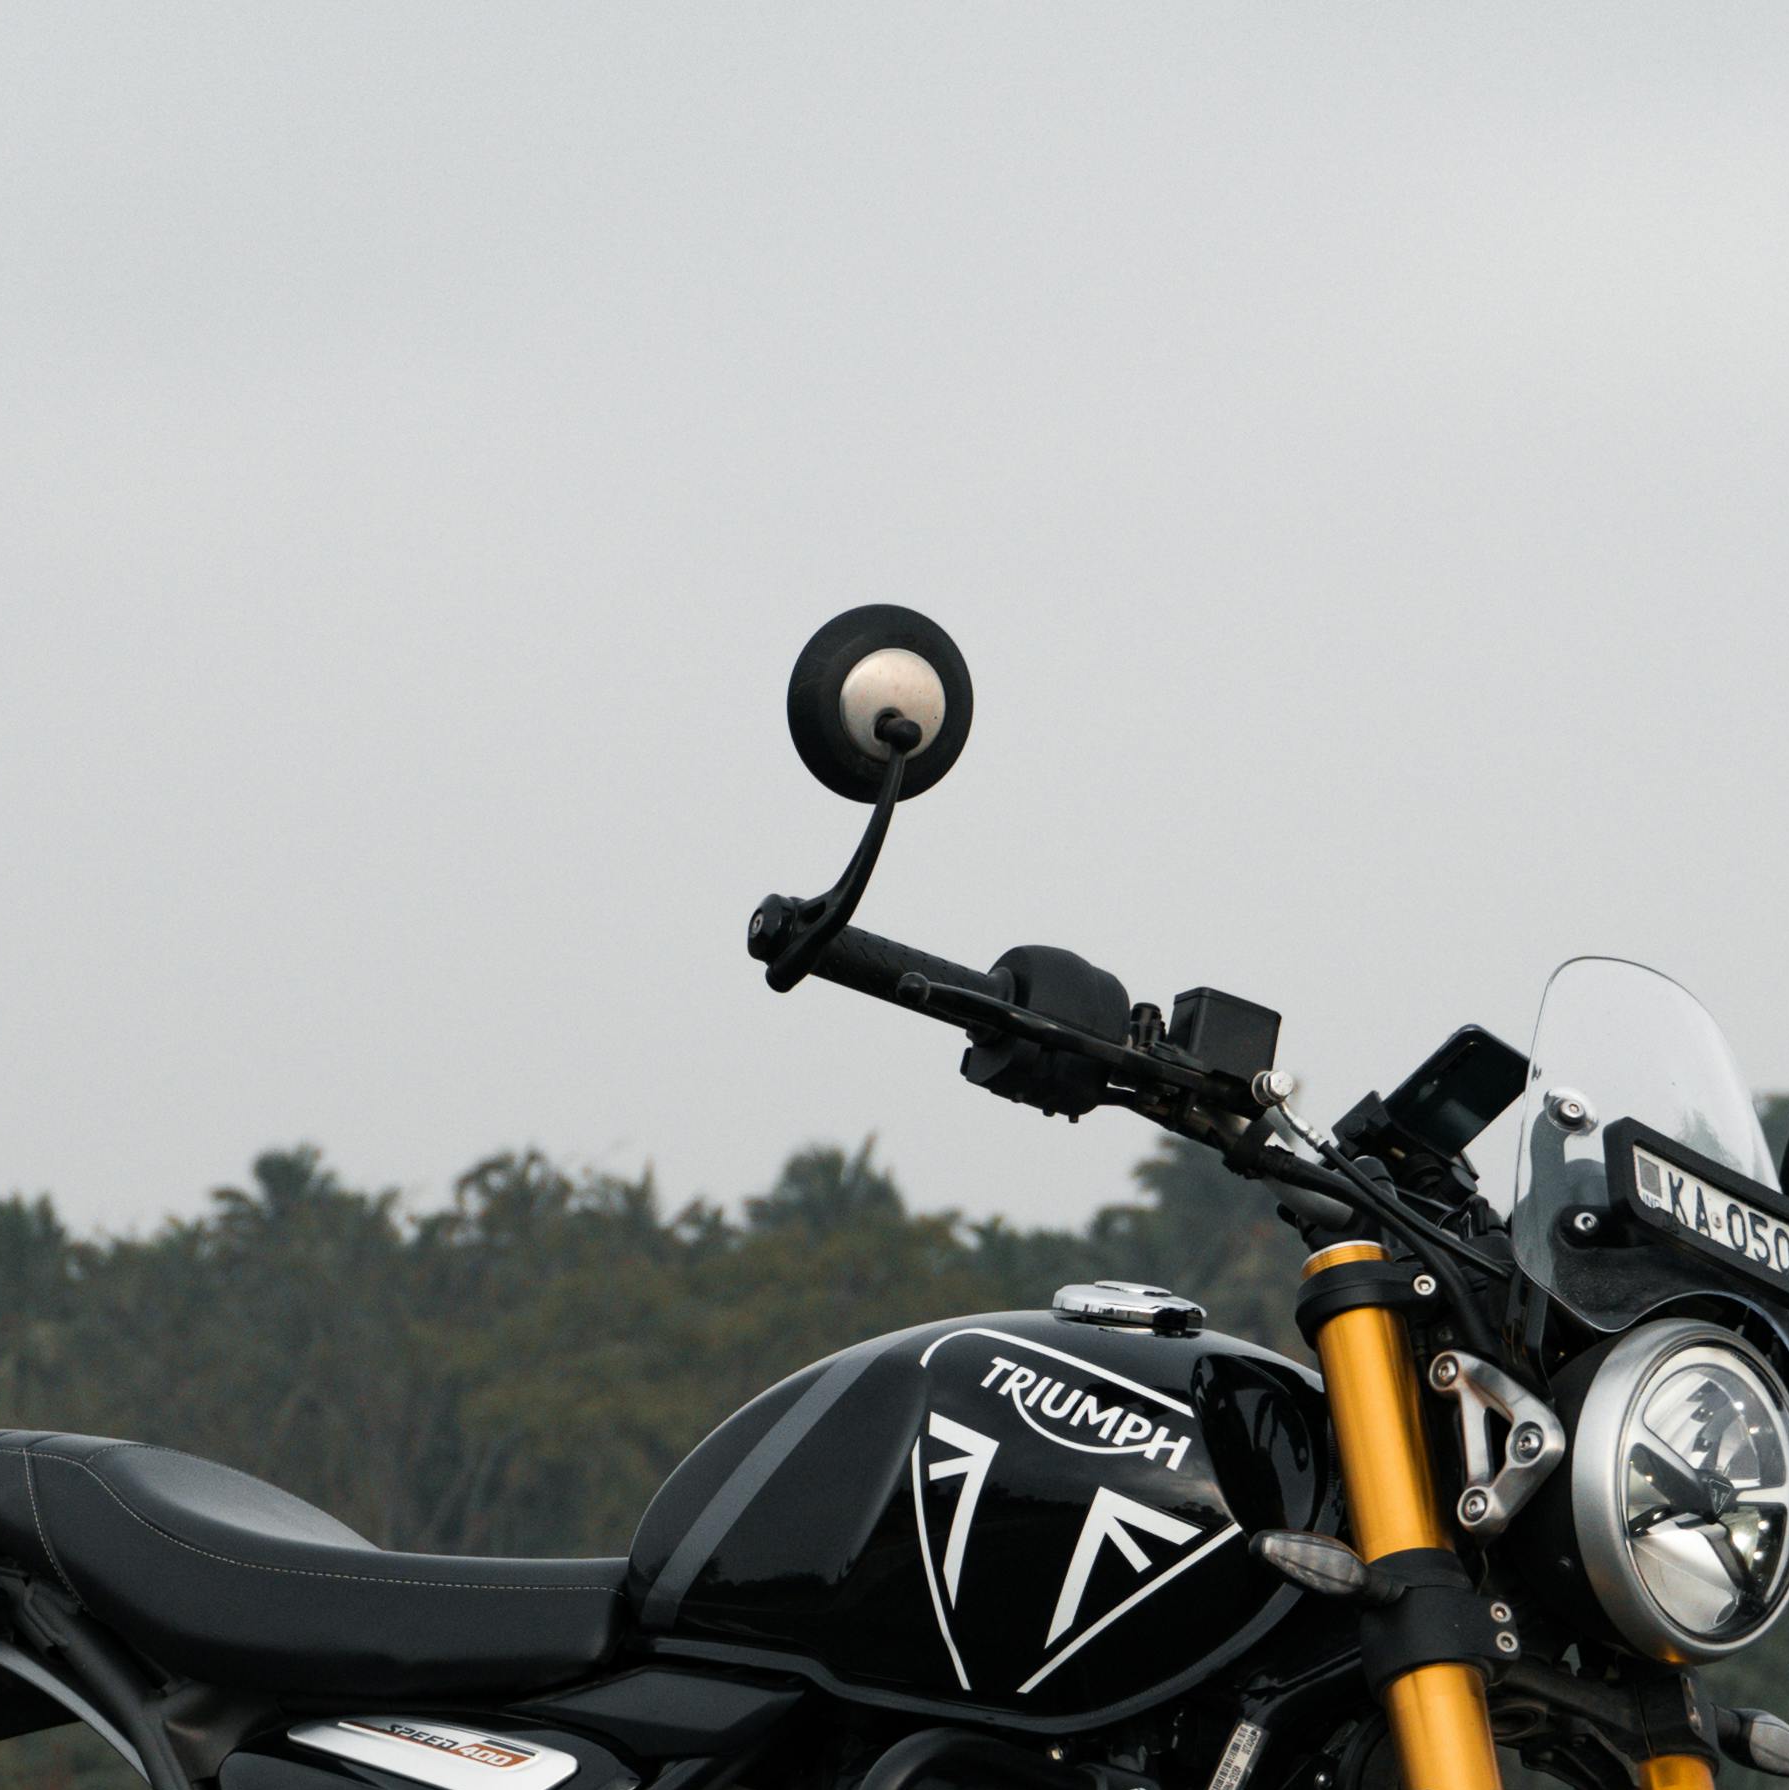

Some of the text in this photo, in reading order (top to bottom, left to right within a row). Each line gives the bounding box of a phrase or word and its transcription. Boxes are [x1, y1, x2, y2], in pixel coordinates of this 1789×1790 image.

[979, 1356, 1192, 1471] TRIUMPH
[388, 1723, 513, 1766] SPEED 400
